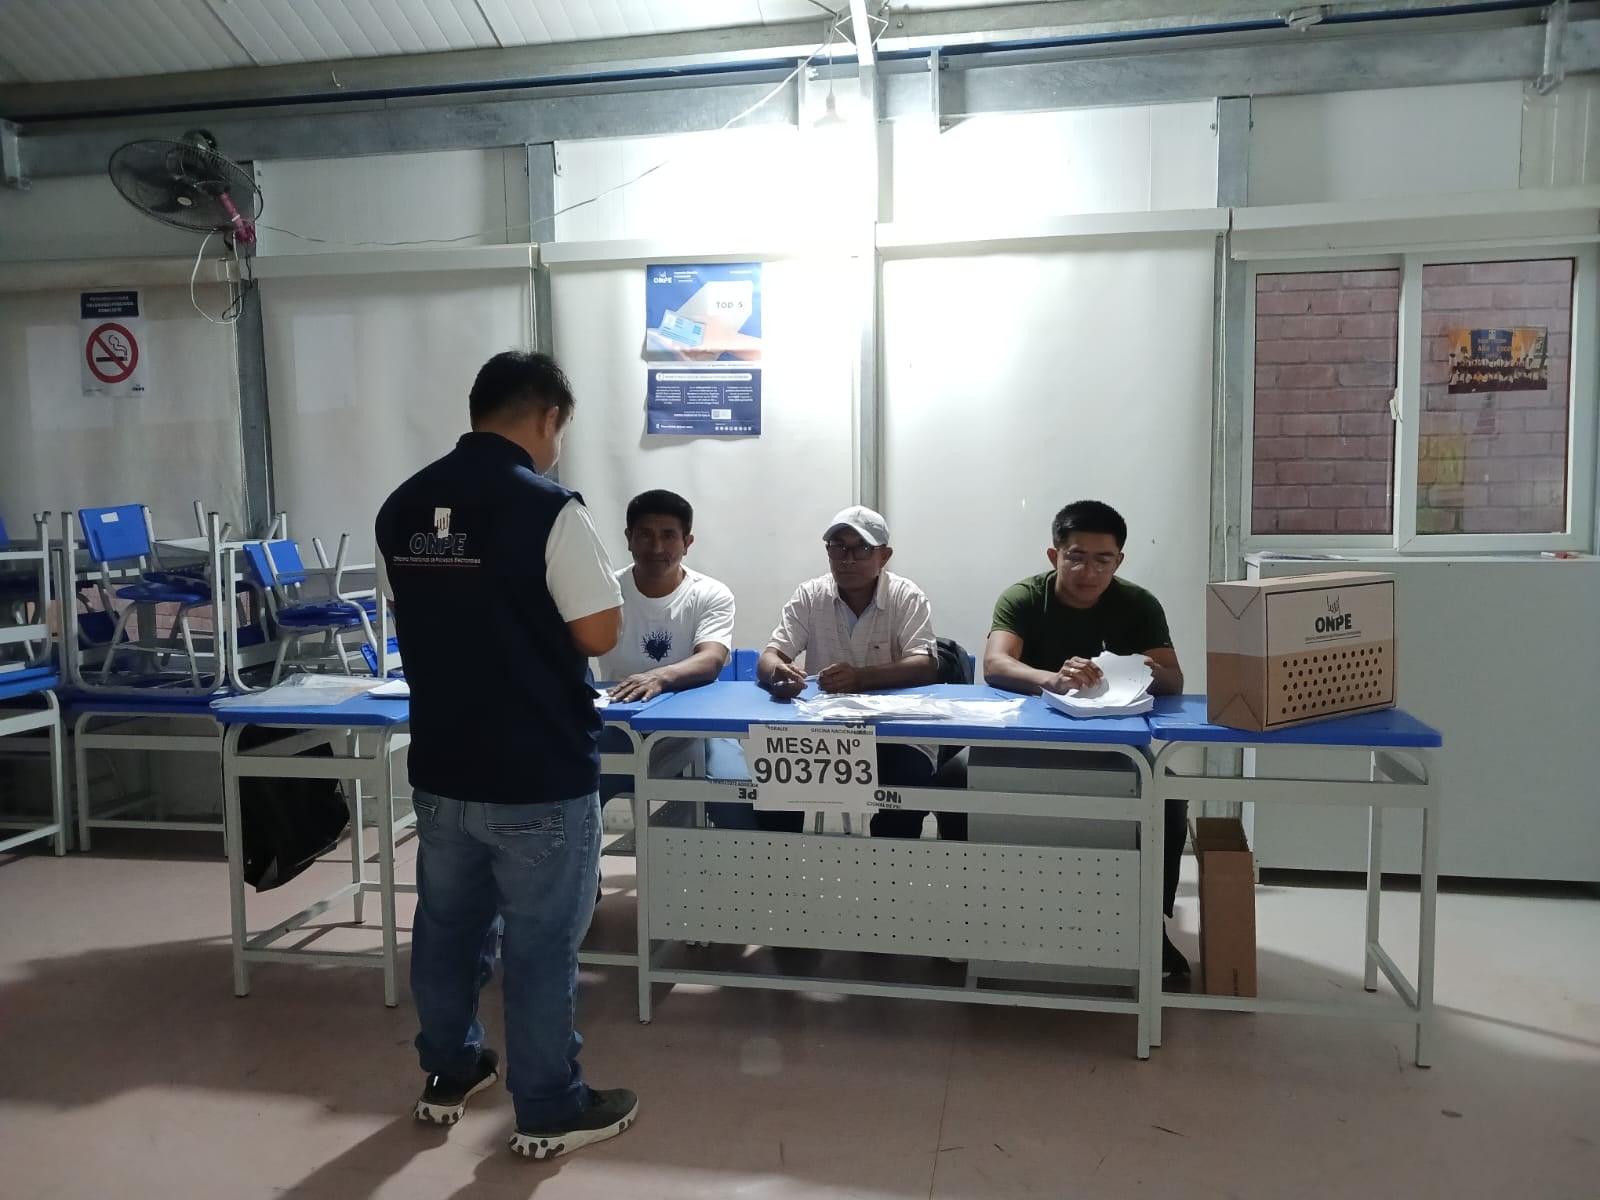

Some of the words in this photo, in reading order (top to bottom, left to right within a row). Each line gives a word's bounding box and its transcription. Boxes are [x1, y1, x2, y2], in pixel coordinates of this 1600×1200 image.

[409, 532, 467, 555] ONPE
[1315, 613, 1352, 633] ONPE
[766, 737, 830, 755] MESA
[754, 757, 873, 785] 903793
